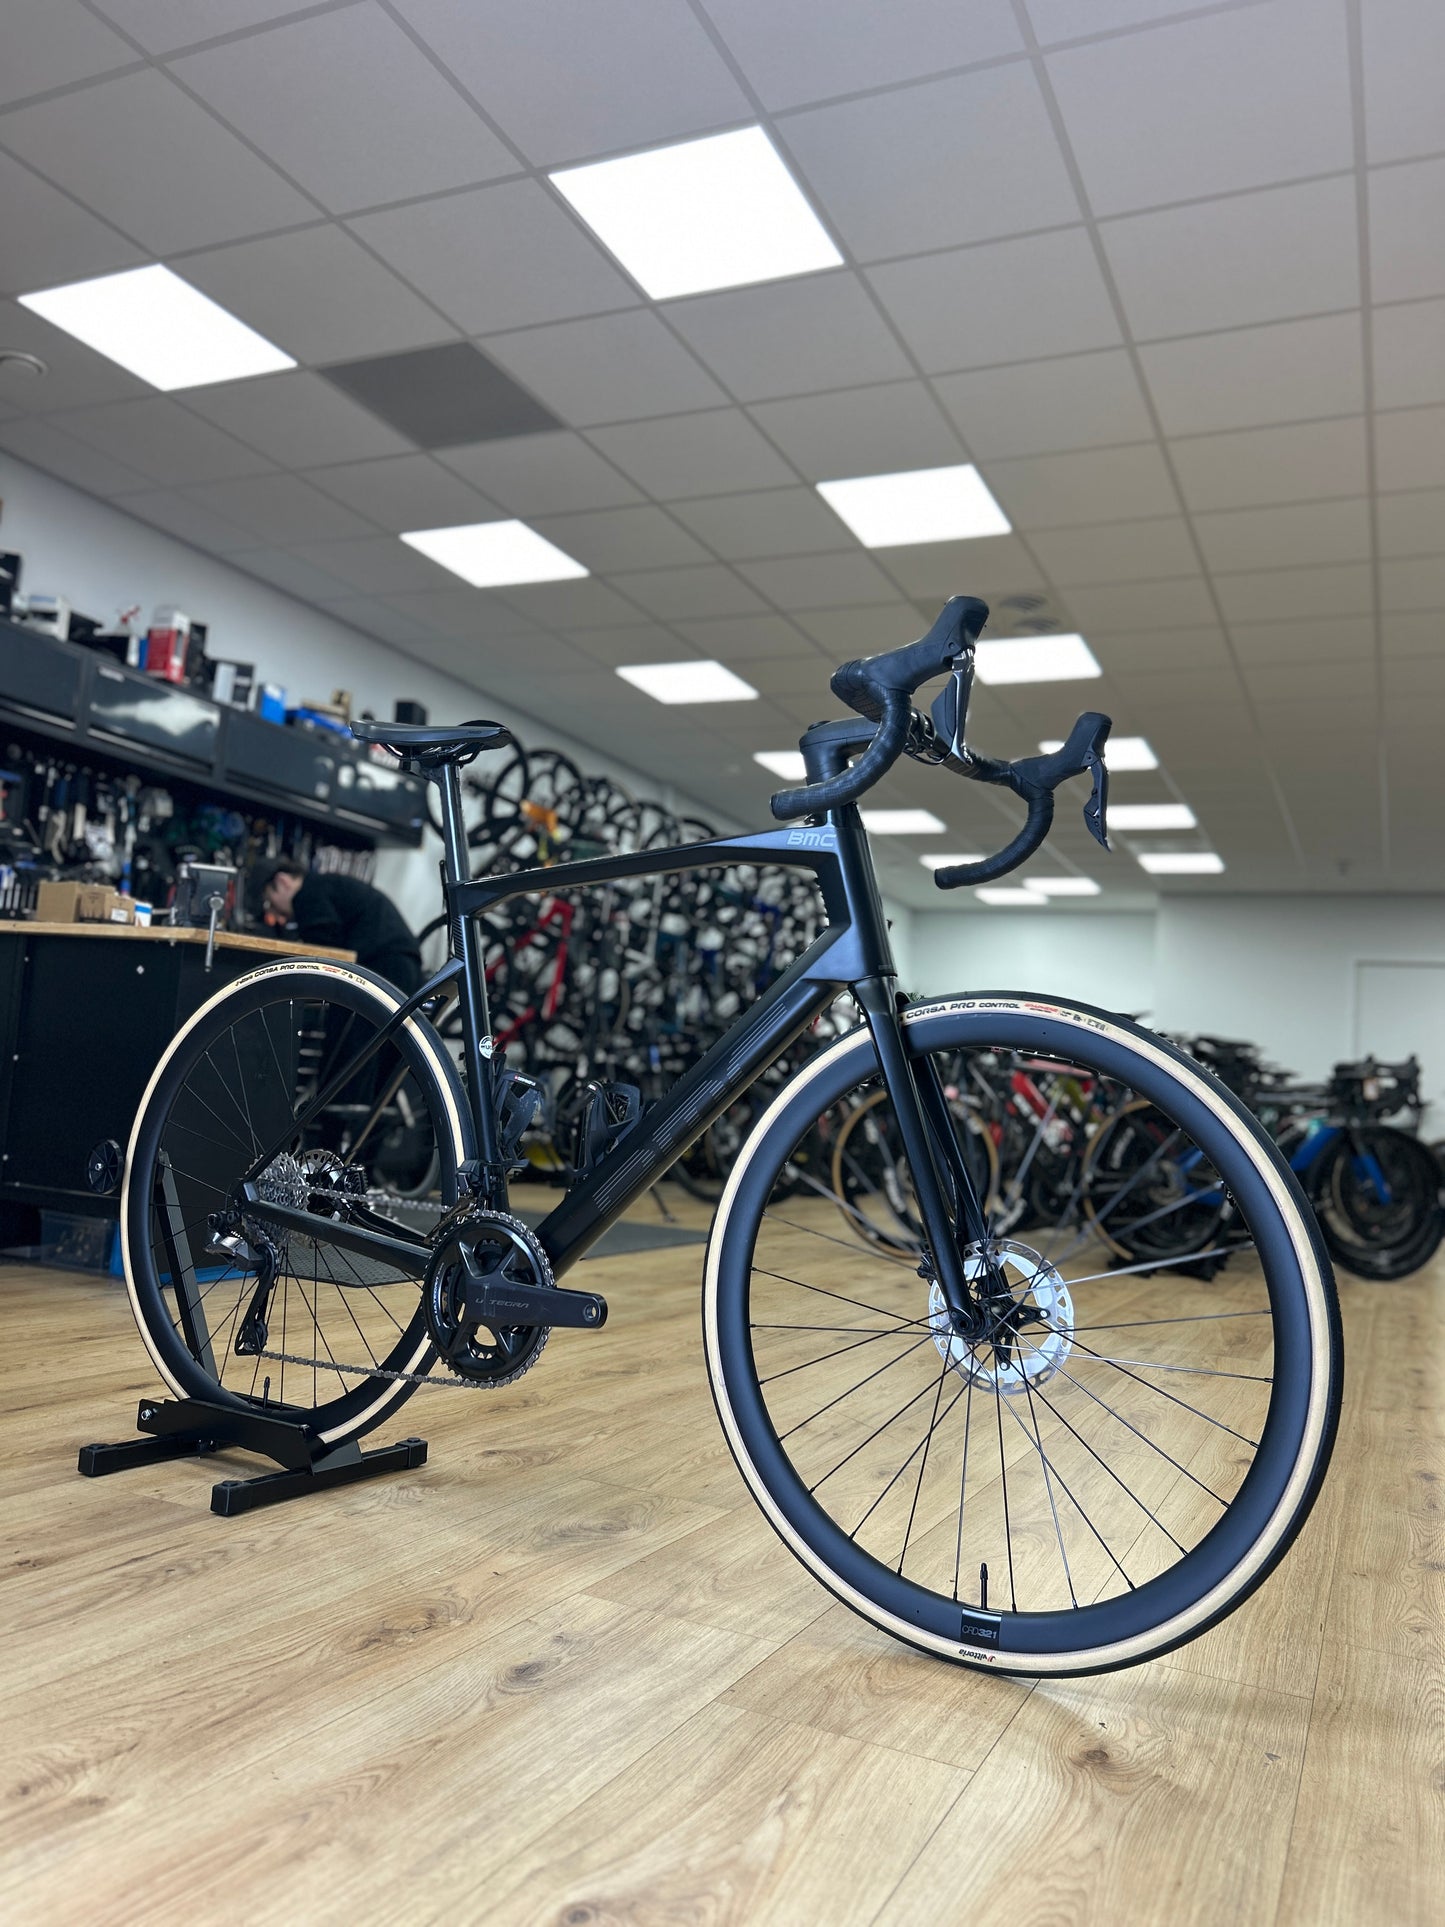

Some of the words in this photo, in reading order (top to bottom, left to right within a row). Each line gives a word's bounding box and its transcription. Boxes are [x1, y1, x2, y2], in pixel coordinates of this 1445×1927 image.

[787, 831, 837, 847] BMC
[906, 1005, 946, 1019] CORSA
[950, 1001, 976, 1010] PRO
[958, 1649, 987, 1661] vittoria
